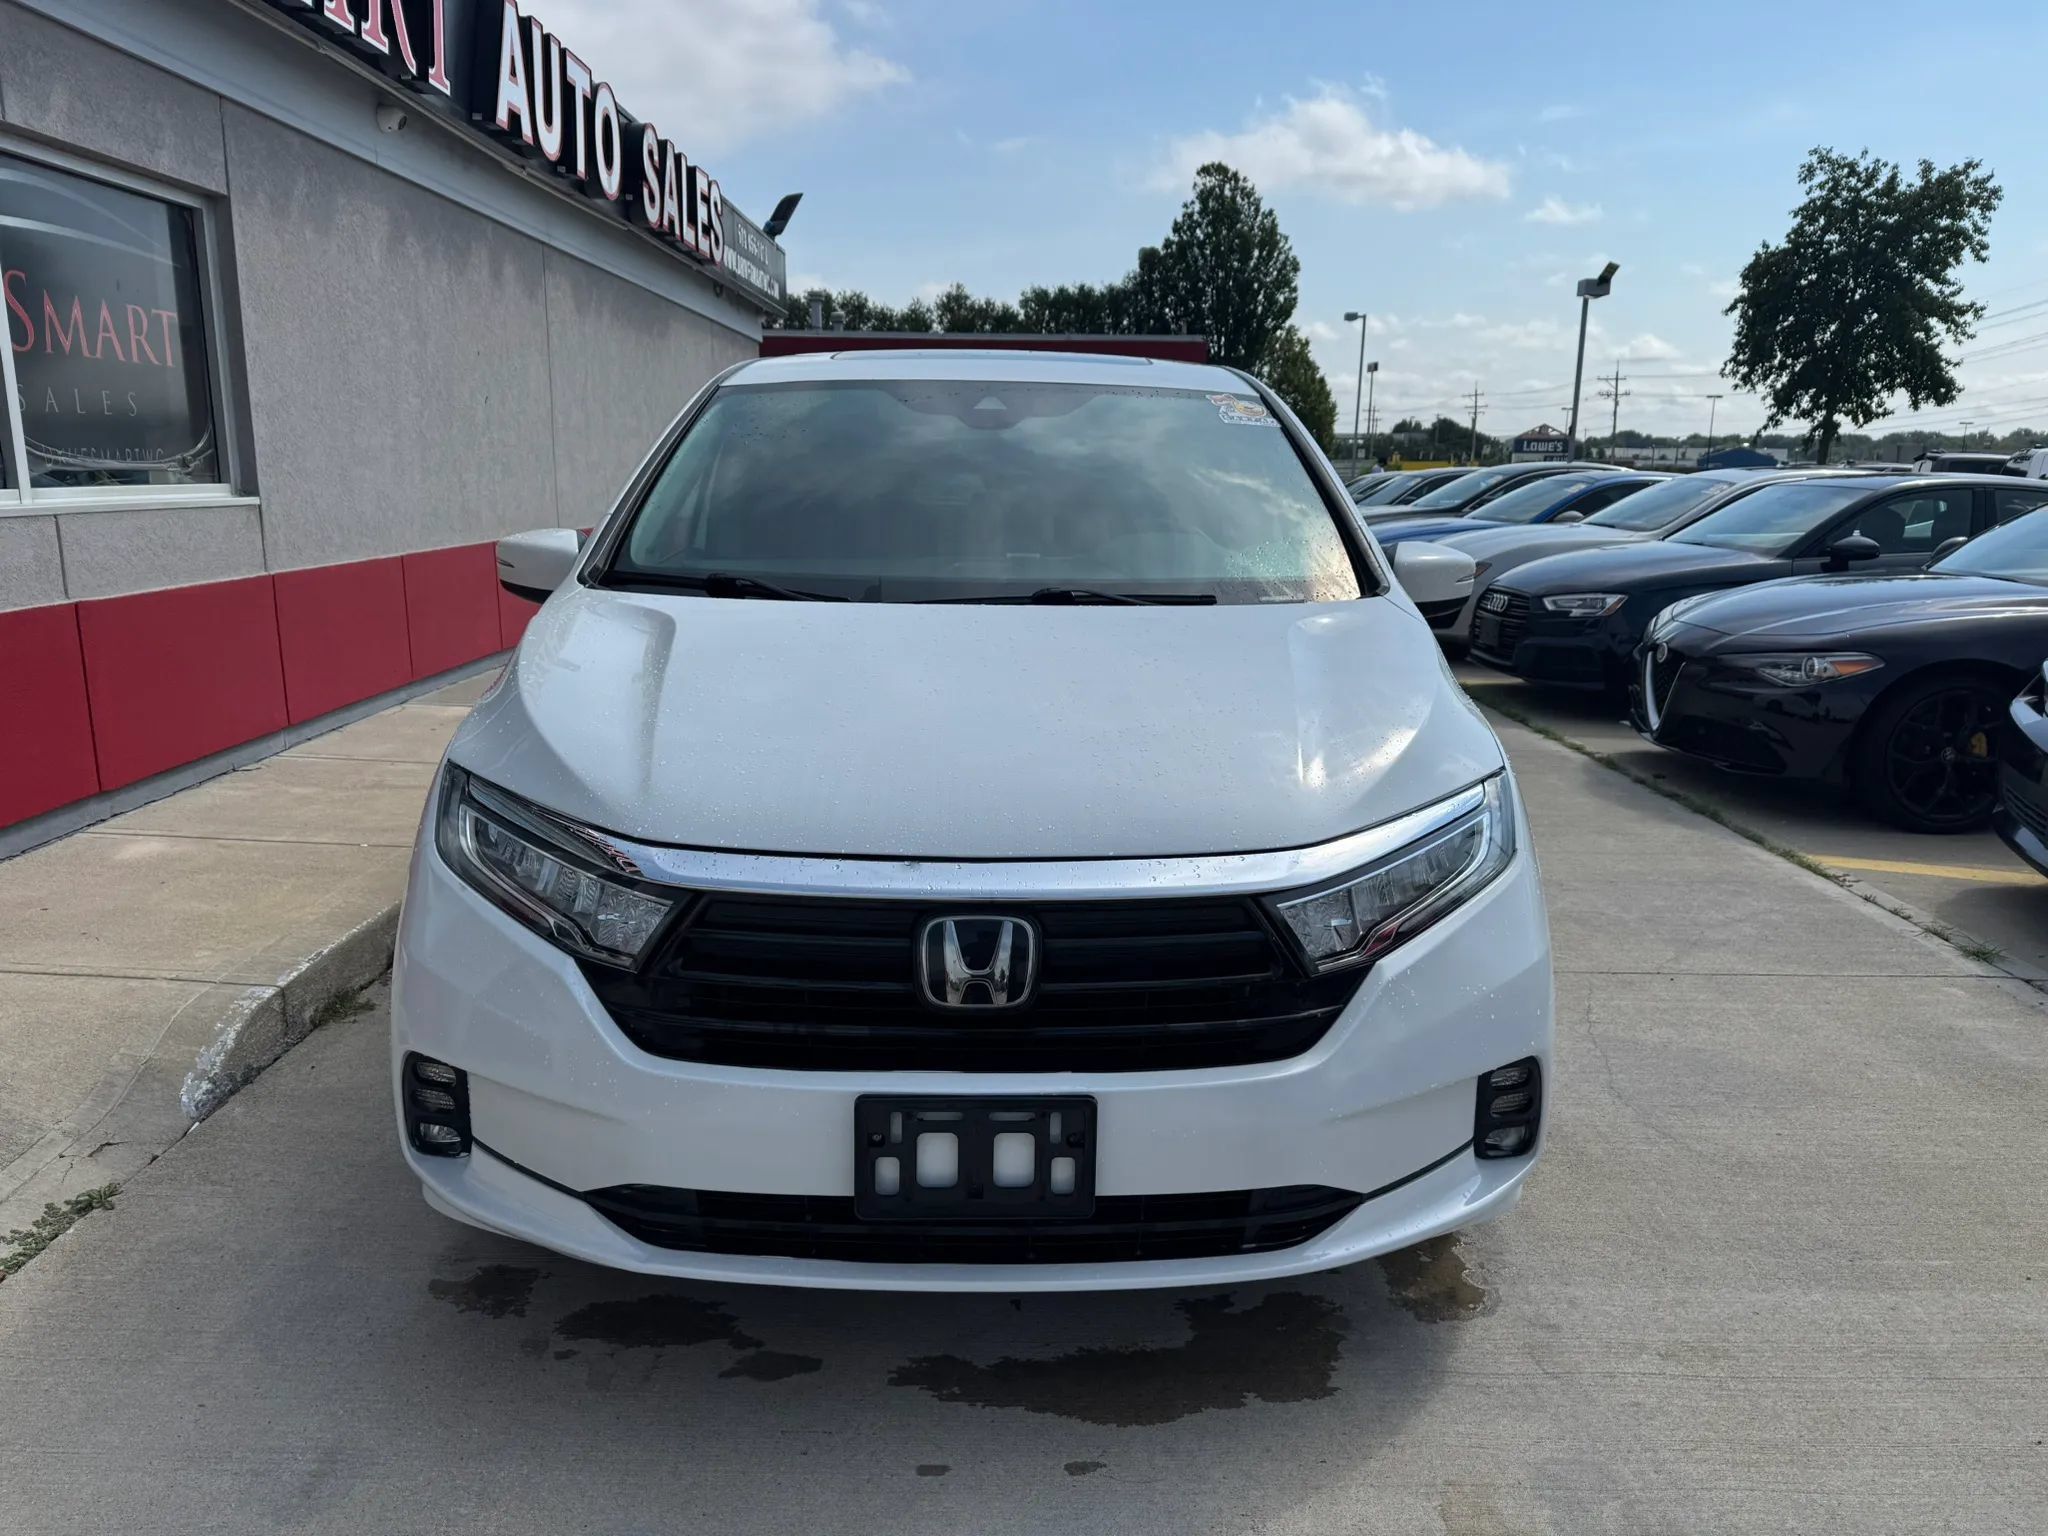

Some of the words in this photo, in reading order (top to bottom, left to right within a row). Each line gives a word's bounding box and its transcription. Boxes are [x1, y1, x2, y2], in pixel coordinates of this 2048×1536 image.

[496, 0, 622, 200] AUTO
[642, 122, 725, 268] SALES
[4, 269, 178, 368] SMART
[17, 383, 138, 417] SALES
